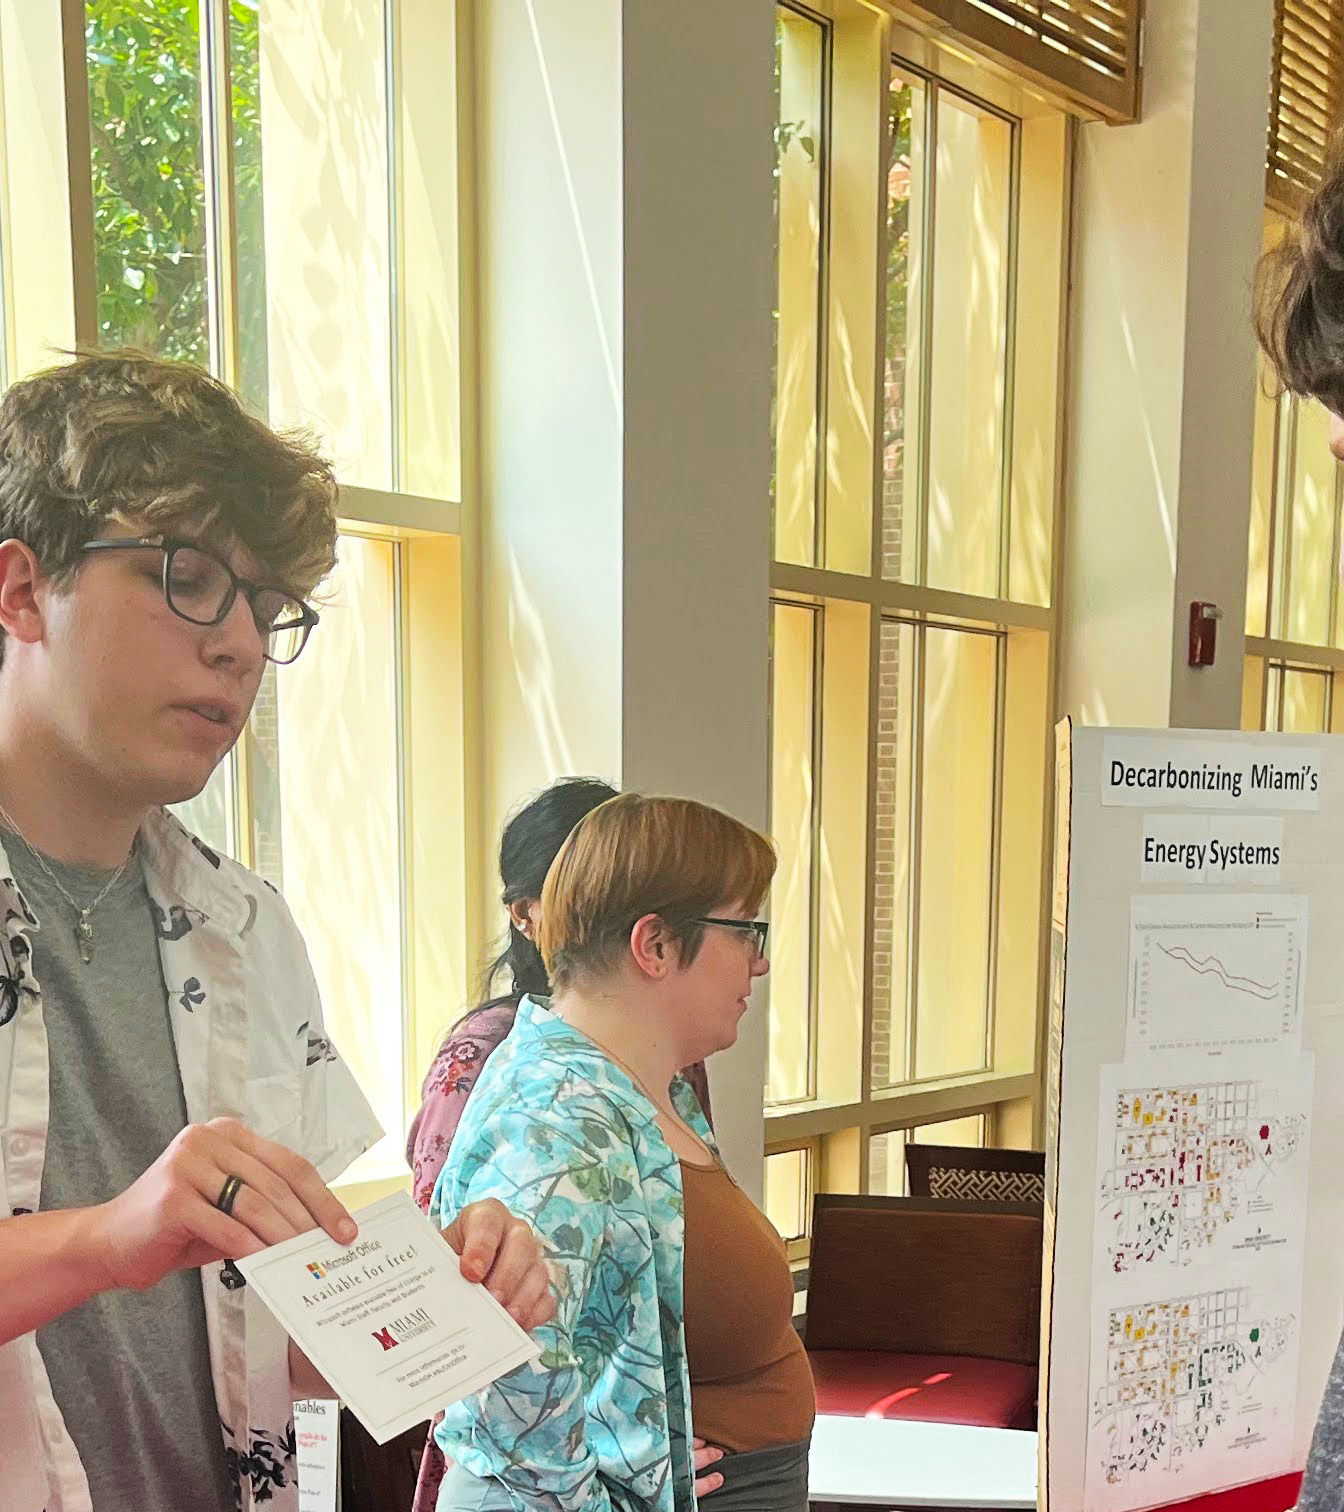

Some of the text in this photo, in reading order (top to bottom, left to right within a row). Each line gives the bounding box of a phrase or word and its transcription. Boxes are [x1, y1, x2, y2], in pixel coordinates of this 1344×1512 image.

[1110, 760, 1318, 797] Decarbonizing Miami's
[1144, 837, 1280, 870] Energy Systems
[302, 1274, 362, 1307] Available
[362, 1265, 384, 1280] for
[389, 1307, 431, 1334] MIAMI
